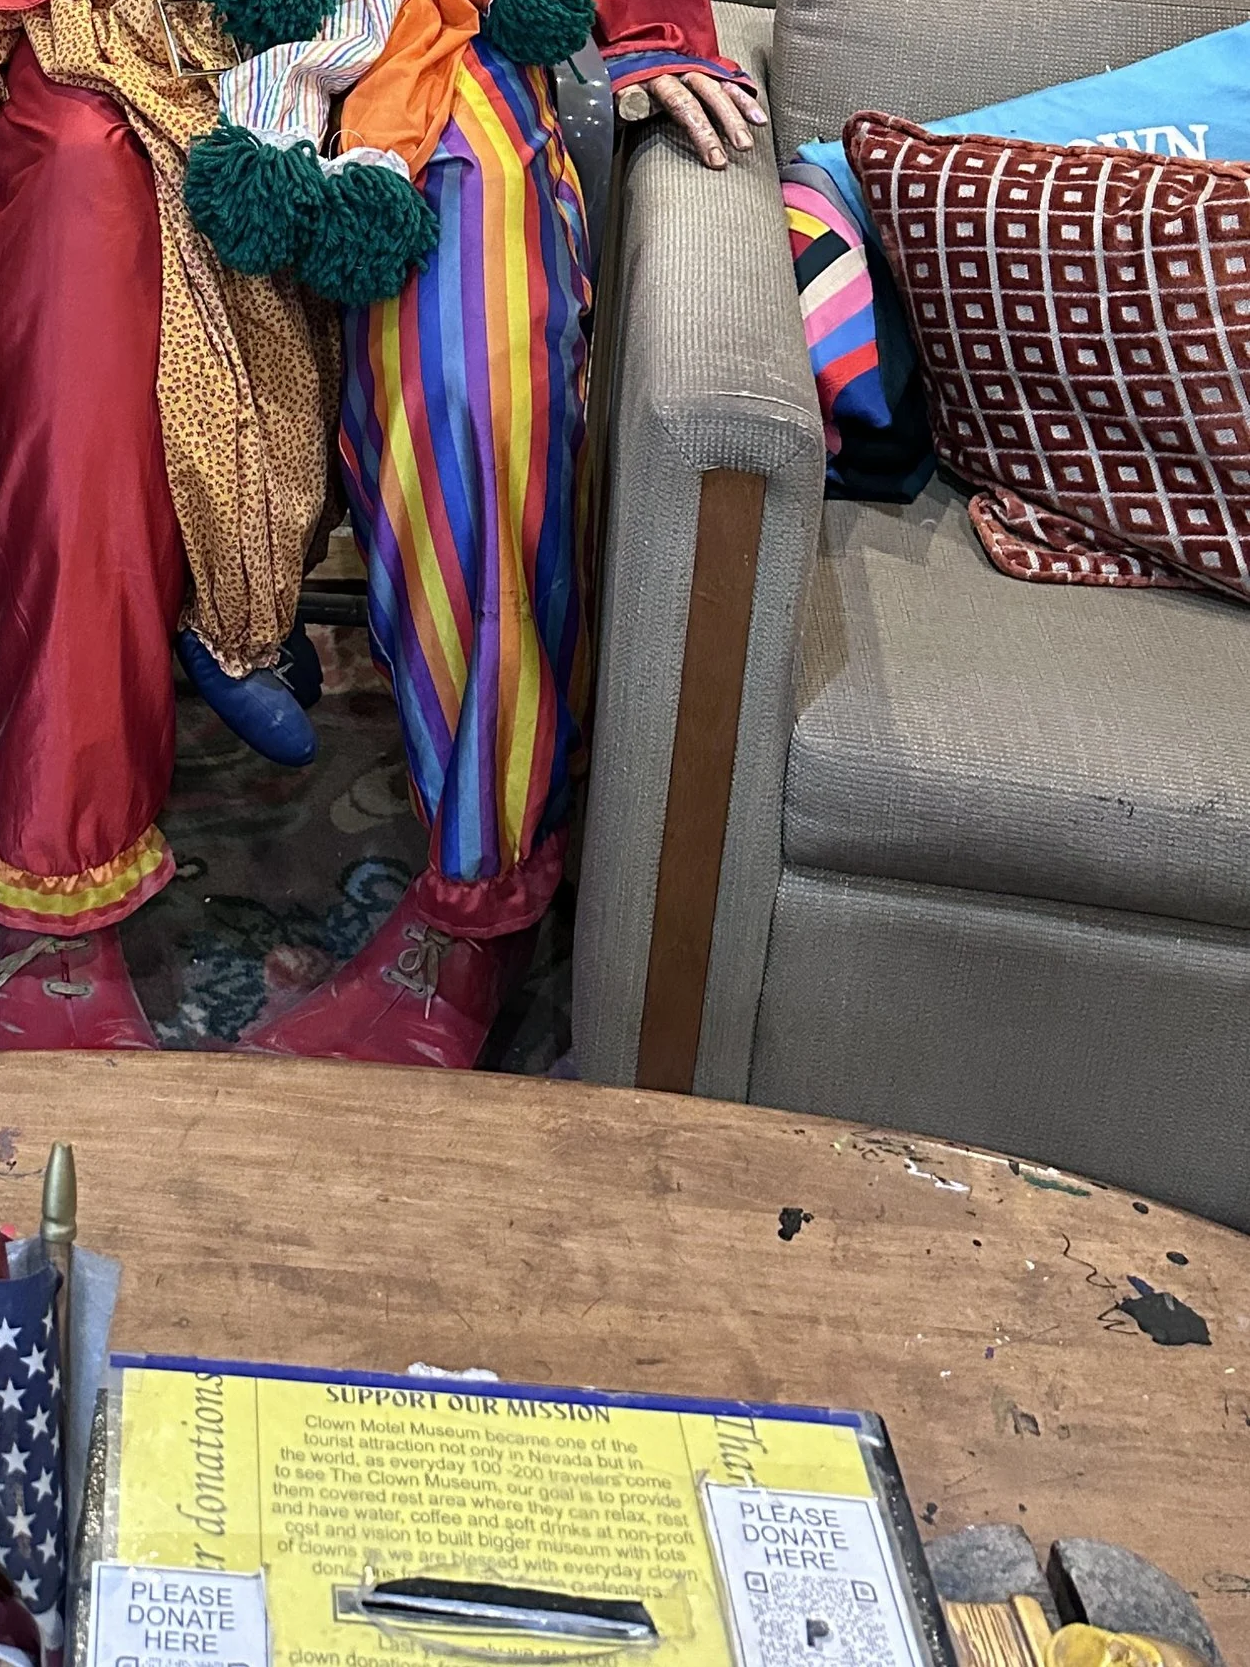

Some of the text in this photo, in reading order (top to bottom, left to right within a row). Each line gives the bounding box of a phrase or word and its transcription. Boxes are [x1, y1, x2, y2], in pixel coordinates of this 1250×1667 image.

[326, 1385, 611, 1424] SUPPORT OUR MISSION
[303, 1432, 644, 1471] tourist attraction not only in Nevada but in
[305, 1414, 638, 1455] Clown Motel Museum became one of the
[274, 1464, 291, 1478] to
[295, 1468, 326, 1481] see
[330, 1467, 363, 1483] The
[367, 1469, 420, 1487] Clown
[506, 1484, 534, 1497] our
[539, 1487, 575, 1502] goal
[579, 1490, 594, 1503] is
[598, 1490, 615, 1504] to
[620, 1493, 682, 1511] provide
[280, 1446, 306, 1462] the
[365, 1455, 385, 1467] as
[389, 1457, 466, 1475] everyday
[471, 1459, 500, 1474] 100
[506, 1464, 544, 1480] -200
[549, 1469, 623, 1486] travelers
[625, 1474, 672, 1491] come
[271, 1500, 303, 1516] and
[308, 1503, 350, 1519] have
[354, 1508, 405, 1524] water,
[410, 1510, 462, 1525] coffee
[467, 1514, 499, 1529] and
[504, 1516, 536, 1532] soft
[540, 1519, 592, 1535] drinks
[596, 1525, 613, 1538] at
[273, 1482, 315, 1498] them
[319, 1487, 386, 1503] covered
[392, 1491, 424, 1505] rest
[428, 1495, 467, 1508] area
[471, 1495, 524, 1512] where
[528, 1500, 563, 1520] they
[568, 1507, 600, 1521] can
[656, 1513, 690, 1528] rest
[740, 1502, 841, 1528] PLEASE
[285, 1521, 687, 1562] cost and vision to built bigger museum with lots
[741, 1523, 849, 1550] DONATE
[277, 1539, 295, 1553] of
[299, 1540, 358, 1557] clowns
[388, 1549, 414, 1561] we
[419, 1551, 448, 1564] are
[451, 1550, 519, 1570] blessed
[524, 1556, 559, 1572] with
[563, 1560, 643, 1581] everyday
[647, 1565, 698, 1583] clown
[764, 1547, 839, 1571] HERE
[131, 1581, 233, 1608] PLEASE
[128, 1603, 236, 1631] DONATE
[144, 1629, 219, 1654] HERE
[288, 1649, 340, 1666] clown
